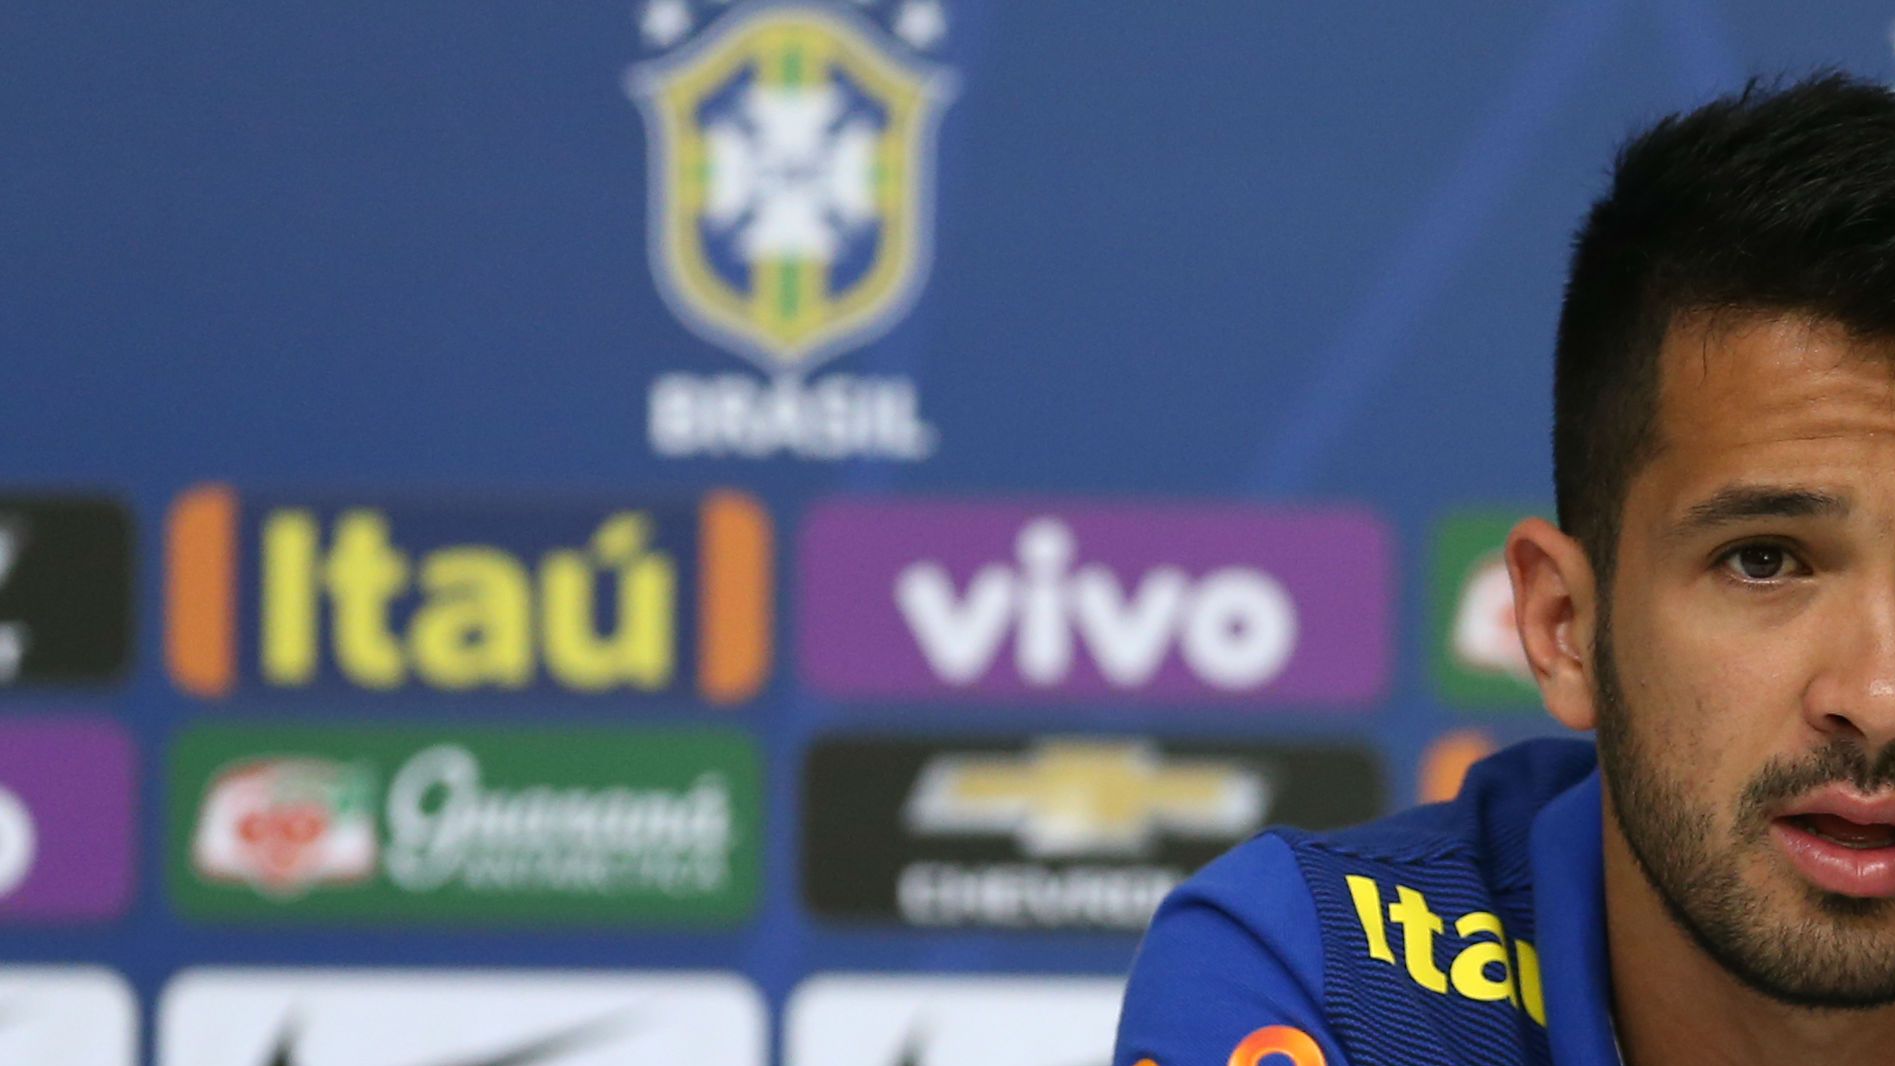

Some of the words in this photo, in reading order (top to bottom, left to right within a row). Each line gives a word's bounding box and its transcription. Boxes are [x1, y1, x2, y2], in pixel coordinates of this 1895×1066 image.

[649, 374, 937, 459] BRASIL
[261, 508, 676, 690] Itaú
[897, 518, 1296, 690] vivo
[896, 860, 1178, 928] CHEVRO
